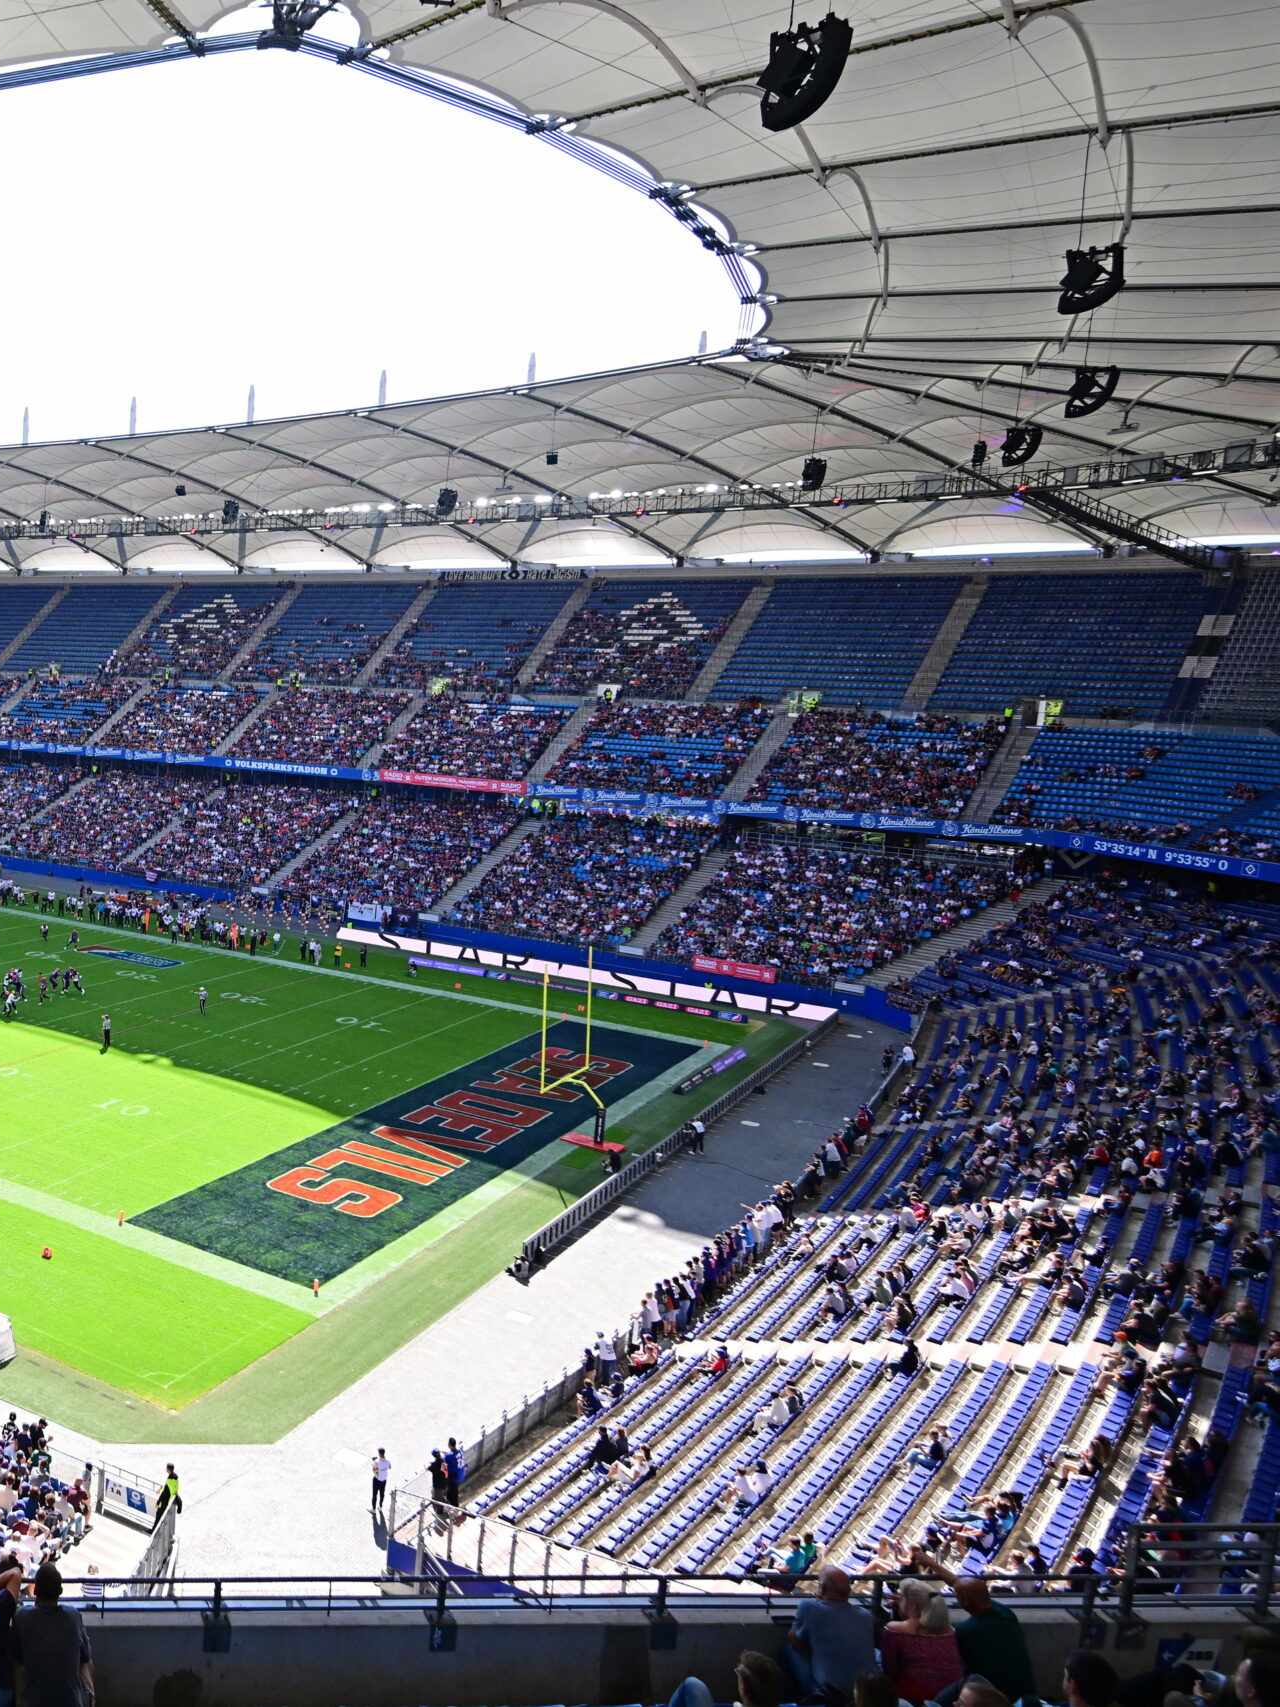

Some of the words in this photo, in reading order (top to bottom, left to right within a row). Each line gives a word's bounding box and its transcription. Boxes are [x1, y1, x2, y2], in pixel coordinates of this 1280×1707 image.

[235, 760, 327, 775] VOLKSPARKSTADION
[728, 802, 751, 812] König
[749, 802, 779, 813] Pilsener
[800, 809, 825, 820] König
[823, 810, 854, 820] Pilsener
[878, 816, 906, 828] König
[904, 816, 936, 828] Pilsener
[962, 824, 990, 836] König
[988, 824, 1024, 836] Pilsener
[1148, 849, 1157, 860] N
[469, 1046, 634, 1103] SEA
[96, 1098, 150, 1116] 10
[266, 1090, 554, 1218] DEVILS
